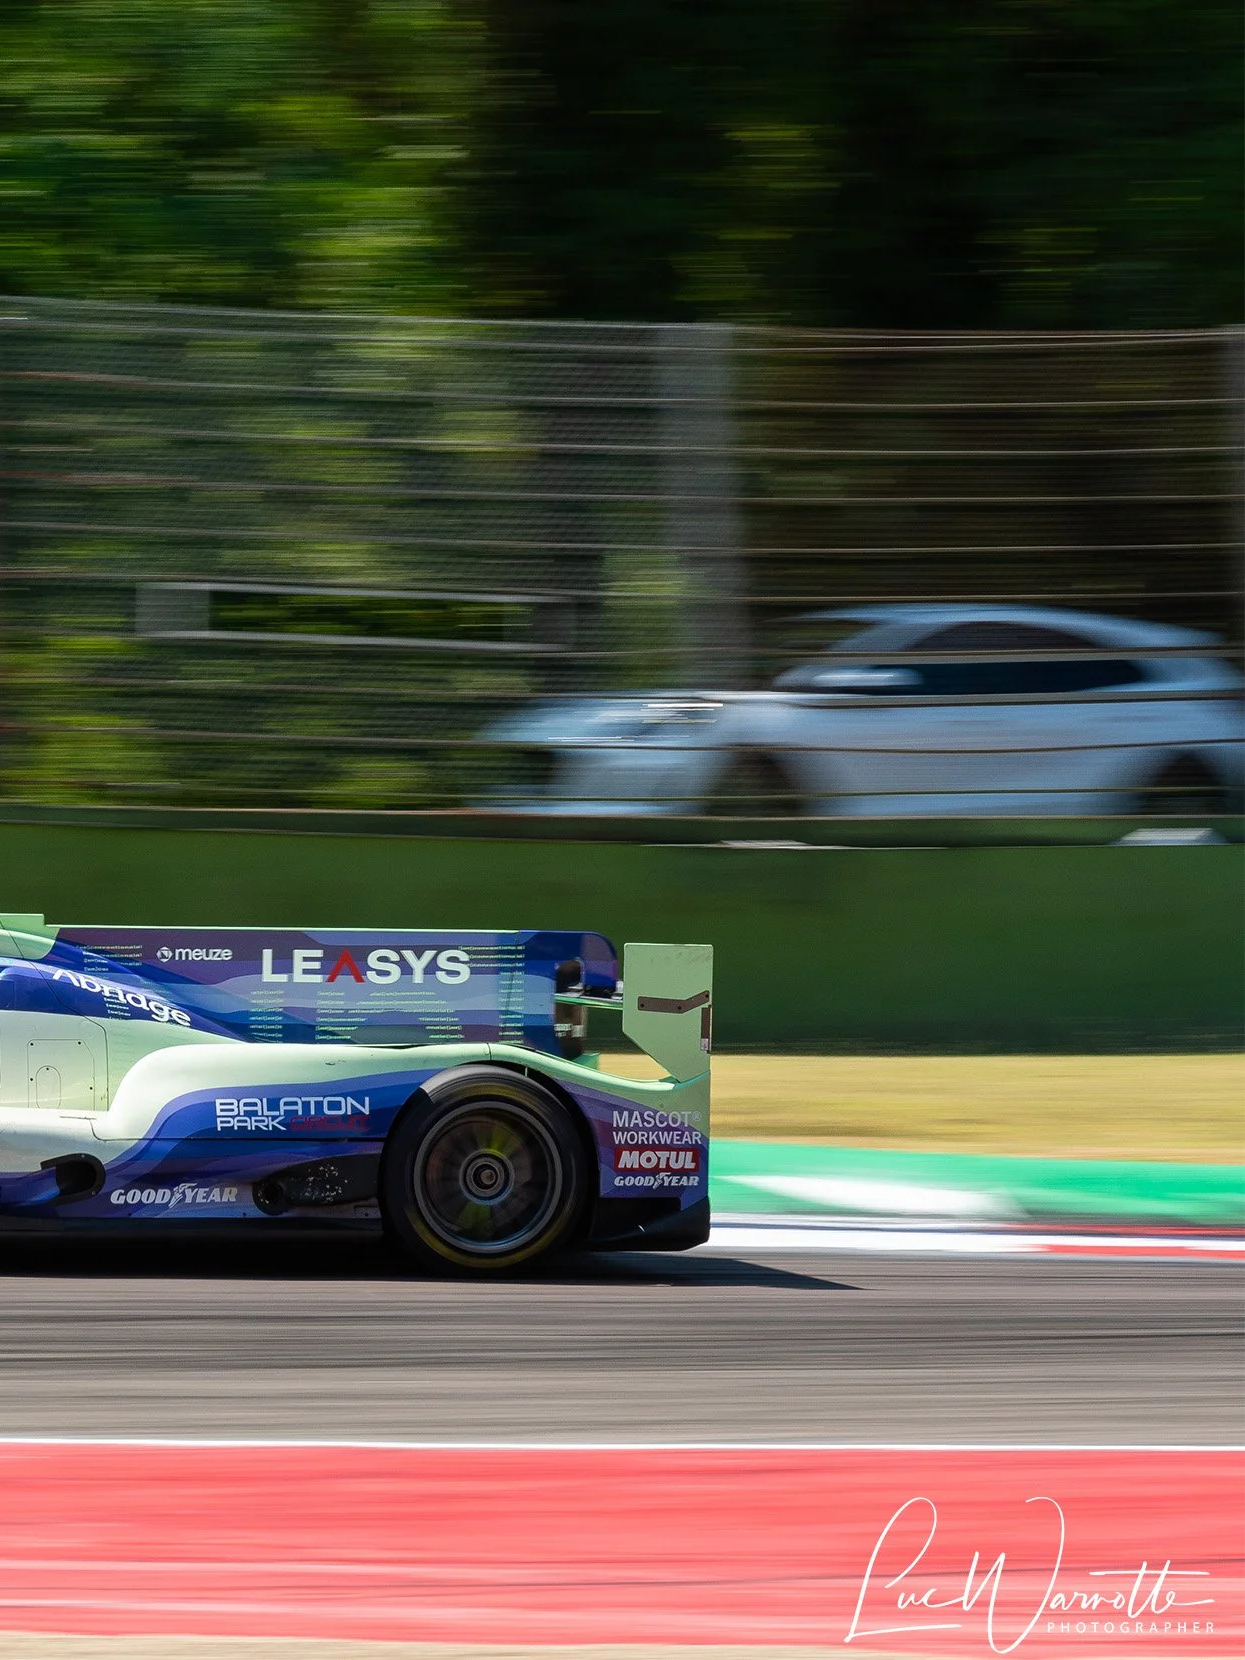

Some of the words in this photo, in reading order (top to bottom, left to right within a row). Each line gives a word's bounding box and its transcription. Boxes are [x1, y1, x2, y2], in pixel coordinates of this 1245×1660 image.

[175, 948, 233, 961] meuze
[262, 948, 471, 985] LEASYS
[52, 969, 191, 1027] Abridge
[215, 1096, 370, 1116] BALATON
[216, 1115, 287, 1131] PARK
[613, 1131, 702, 1145] WORKWEAR
[618, 1151, 696, 1169] MOTUL
[614, 1172, 700, 1190] GOODYEAR
[110, 1182, 238, 1209] GOODYEAR
